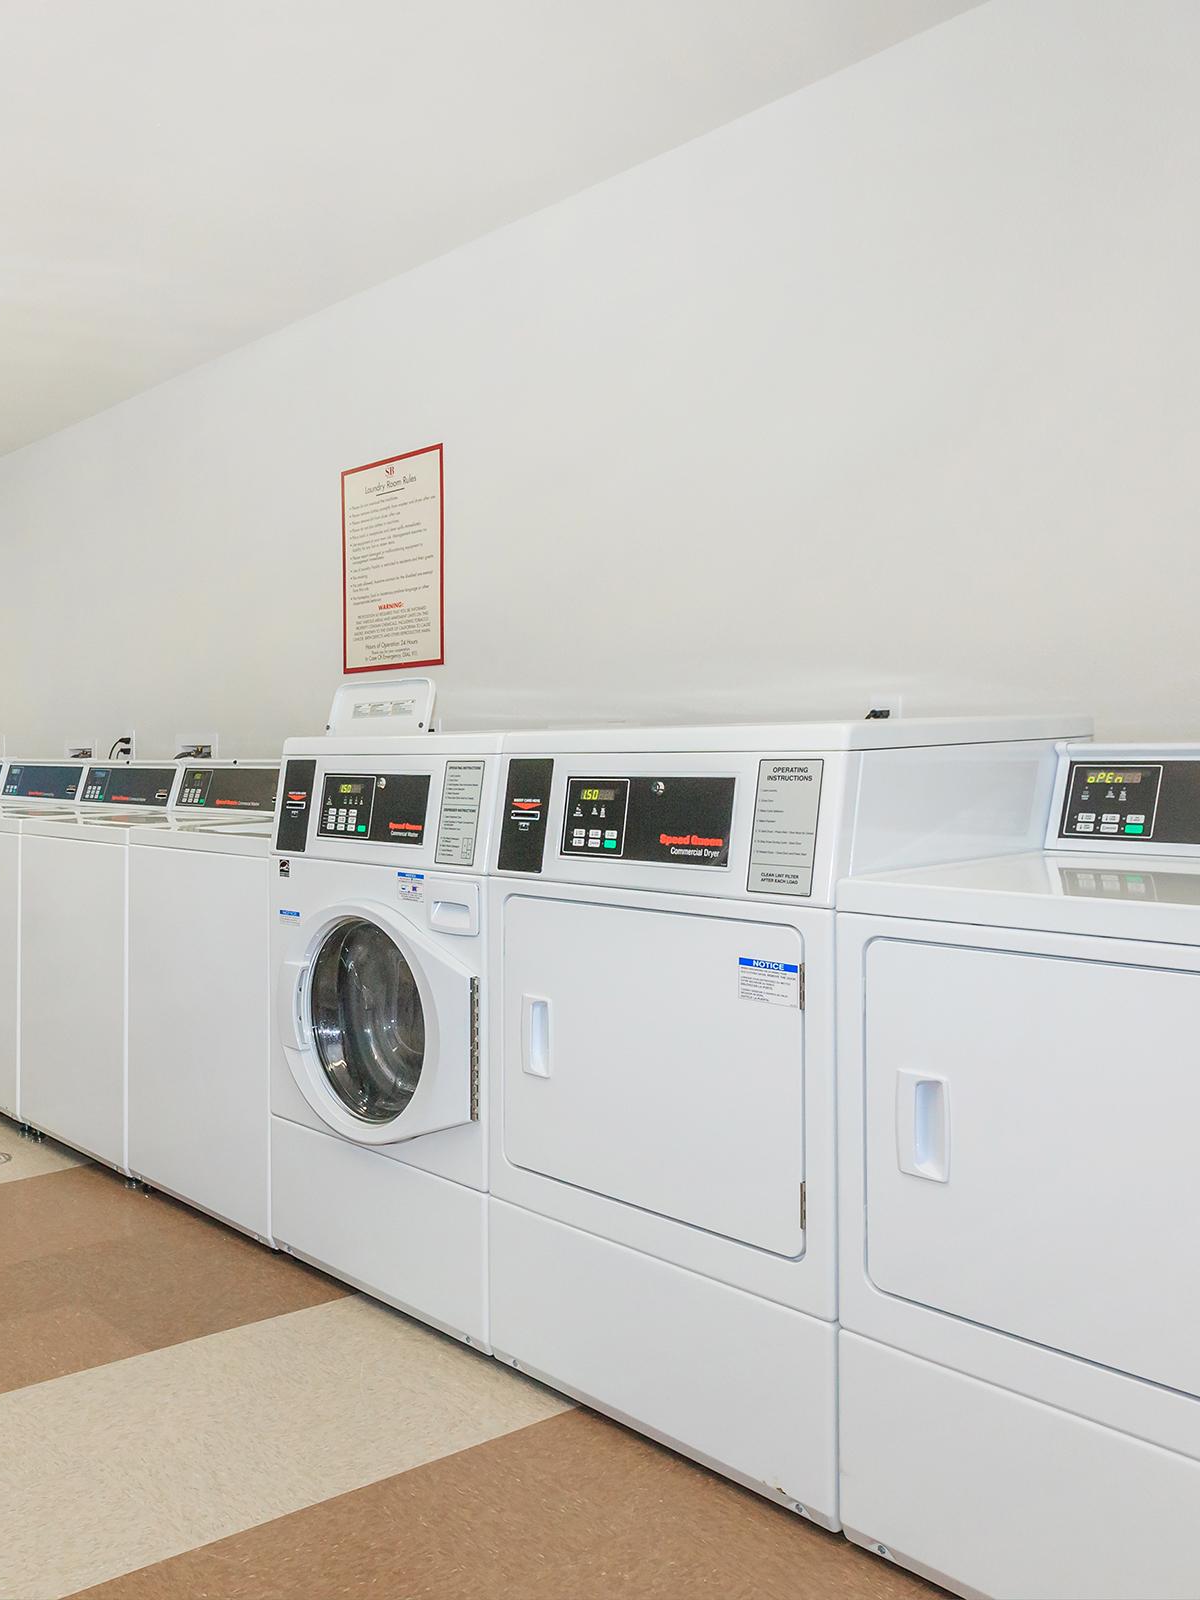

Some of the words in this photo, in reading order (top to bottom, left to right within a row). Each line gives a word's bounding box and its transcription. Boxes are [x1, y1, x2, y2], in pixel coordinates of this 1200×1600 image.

[364, 481, 386, 495] Laundry
[386, 479, 402, 489] Room
[403, 474, 417, 485] Rules
[772, 766, 809, 774] OPERATING
[660, 833, 691, 846] Speed
[691, 834, 723, 847] Queen
[670, 846, 703, 857] Commercial
[704, 848, 720, 859] Dryer
[752, 959, 785, 971] NOTICE
